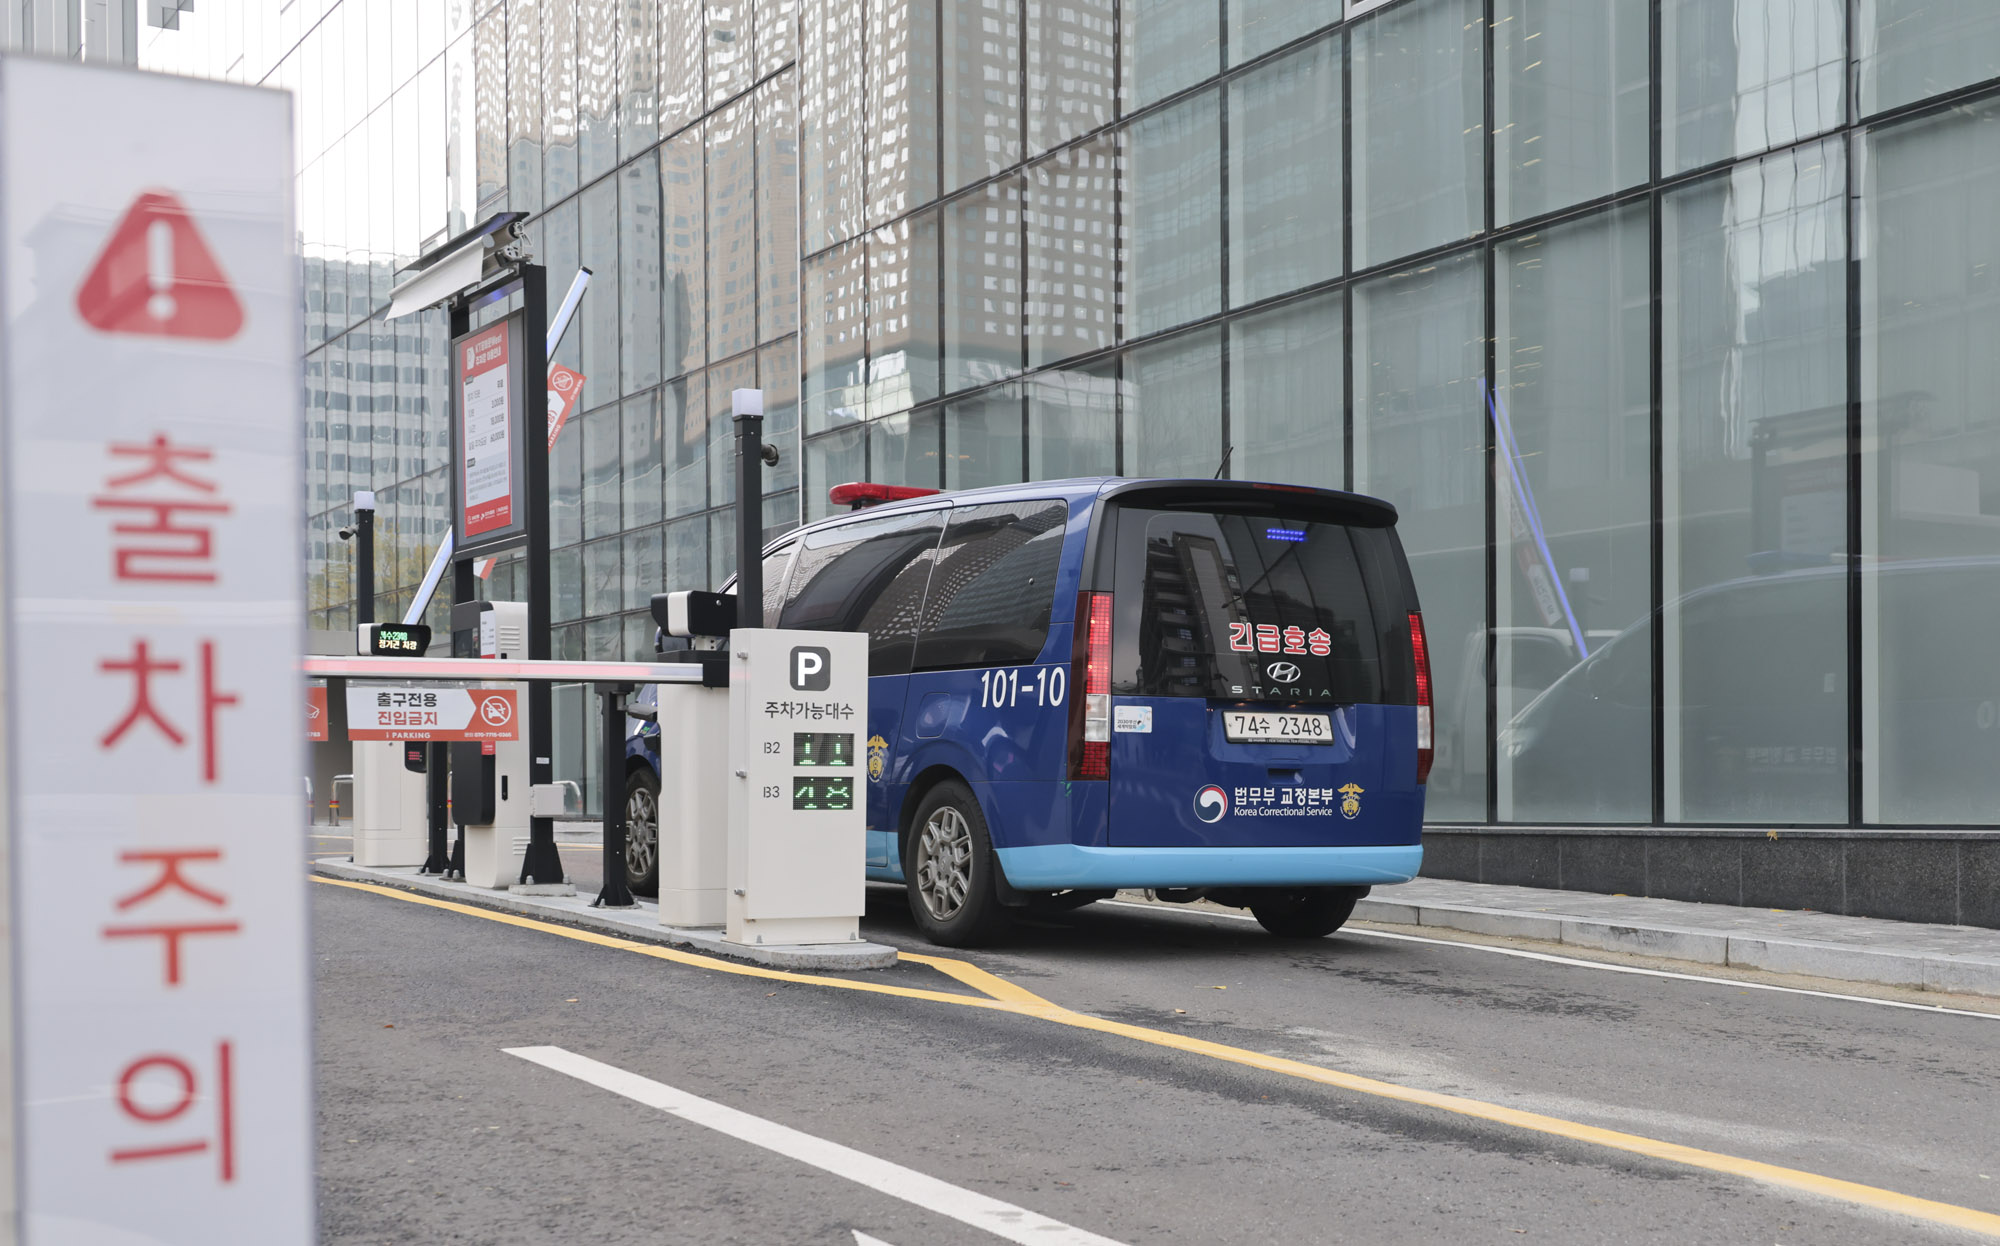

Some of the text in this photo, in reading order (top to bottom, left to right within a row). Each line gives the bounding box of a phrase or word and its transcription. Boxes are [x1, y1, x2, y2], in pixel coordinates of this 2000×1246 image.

[1229, 622, 1332, 657] 긴급호송
[797, 651, 823, 687] P
[981, 666, 1066, 708] 101-10
[1231, 685, 1332, 697] STARIA
[377, 692, 438, 708] 출구전용
[377, 711, 438, 726] 진입금지
[764, 701, 855, 721] 주차가능대수
[1234, 715, 1323, 737] 74수 2348
[763, 741, 781, 754] B2
[763, 785, 780, 798] B3
[1234, 787, 1333, 806] 법무부 교정본부
[89, 430, 243, 1188] 출차주의
[1234, 806, 1333, 817] Korea Correctional Service
